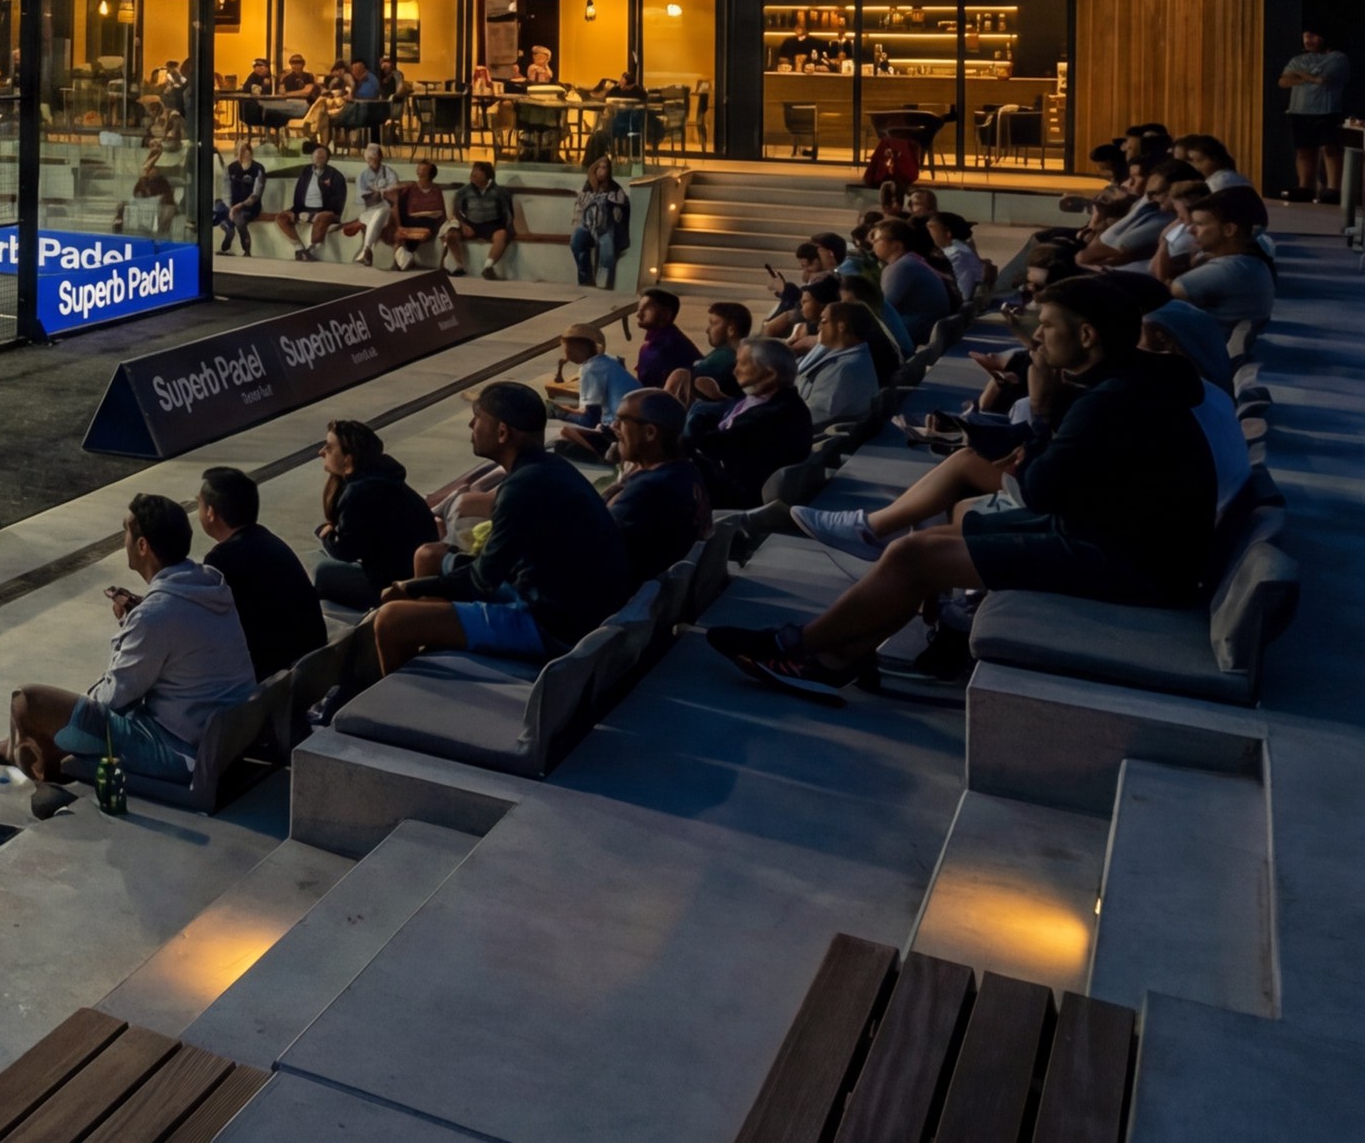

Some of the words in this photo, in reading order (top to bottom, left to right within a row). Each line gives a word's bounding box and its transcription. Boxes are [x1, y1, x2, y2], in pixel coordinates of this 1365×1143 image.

[59, 269, 125, 319] Superb
[128, 258, 174, 300] Padel
[152, 360, 220, 413] Superb
[218, 344, 267, 390] Padel
